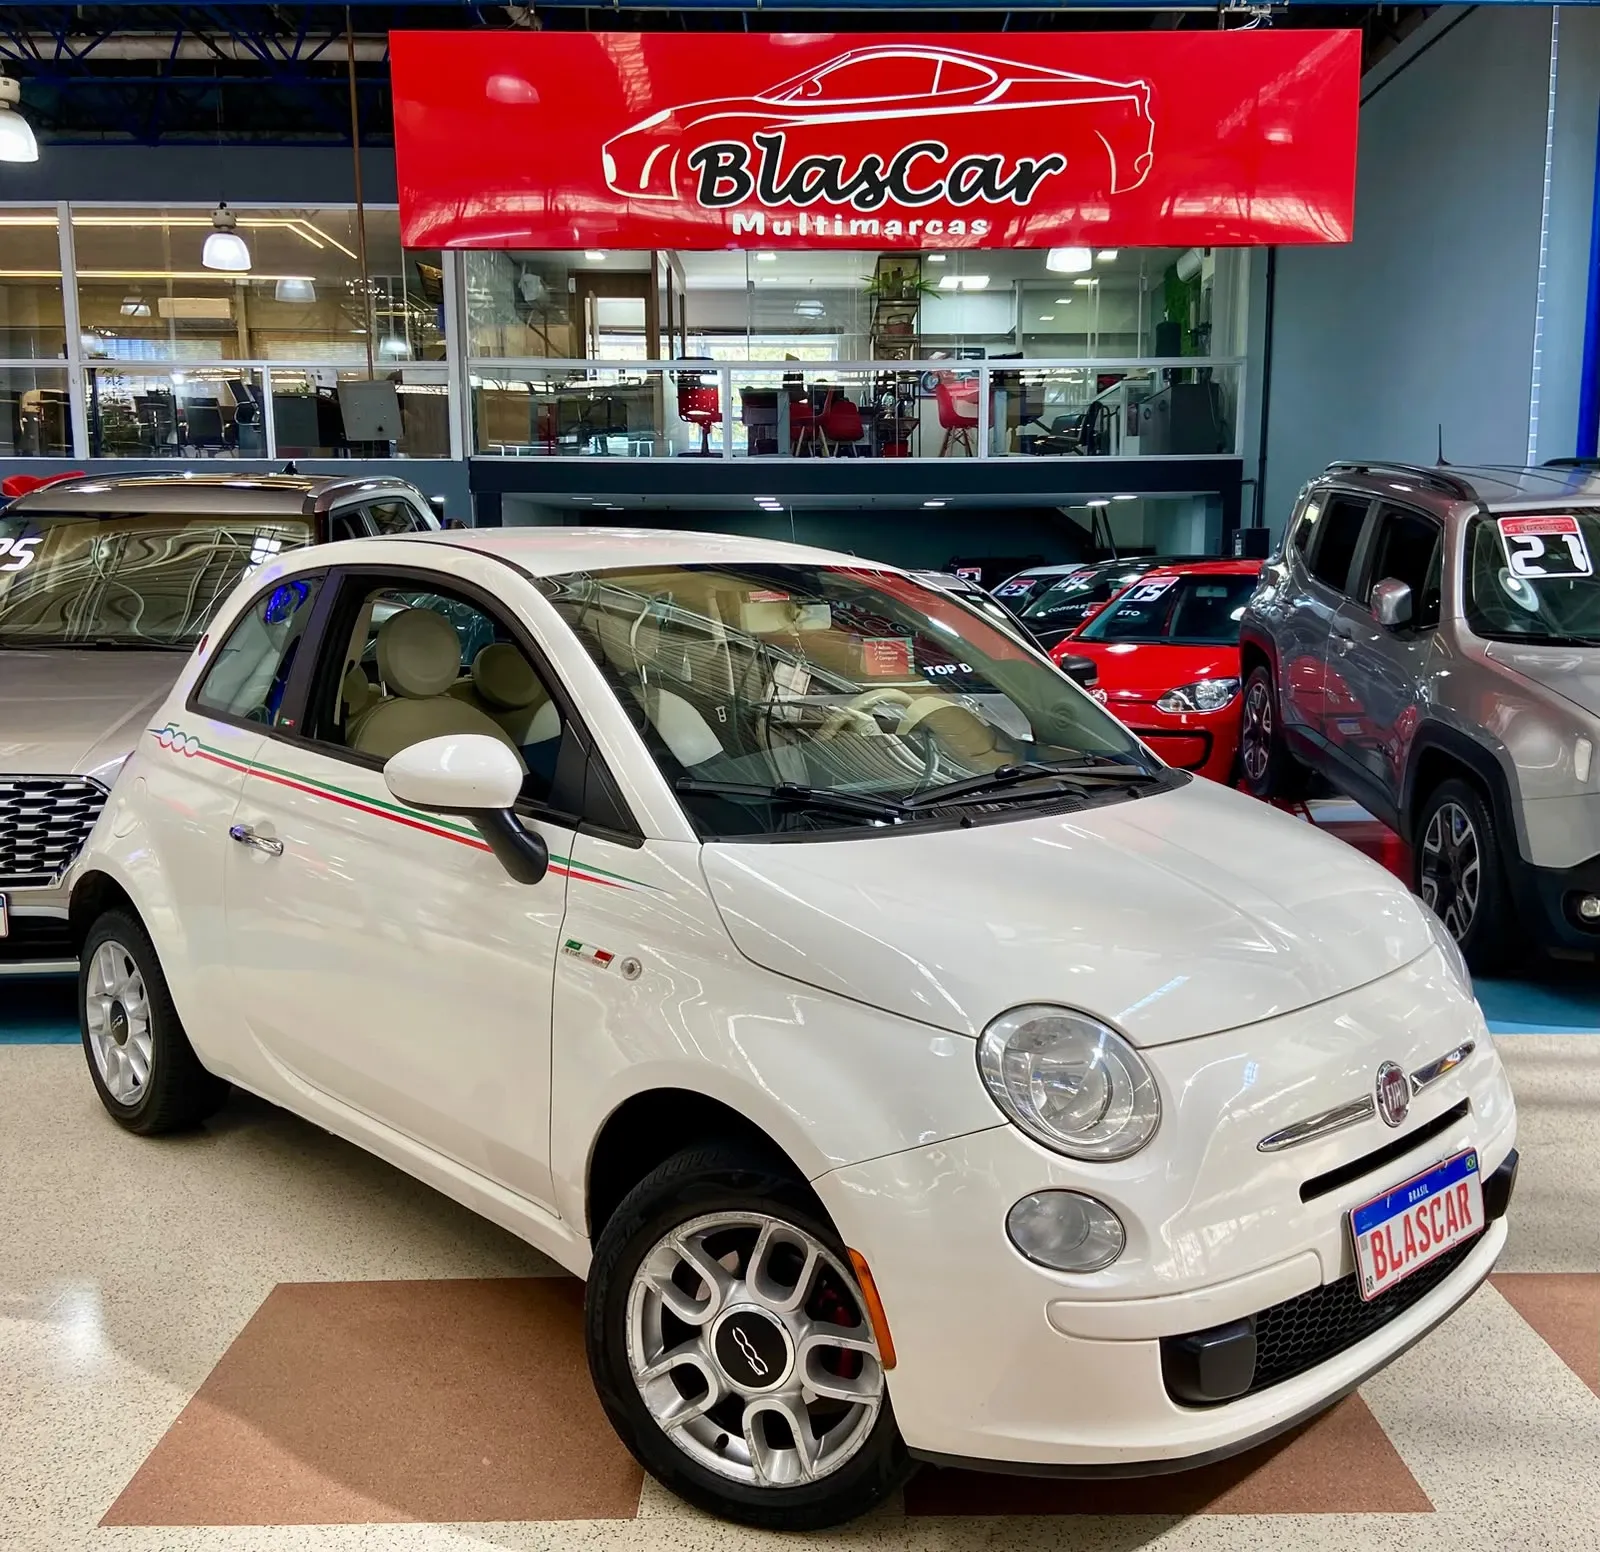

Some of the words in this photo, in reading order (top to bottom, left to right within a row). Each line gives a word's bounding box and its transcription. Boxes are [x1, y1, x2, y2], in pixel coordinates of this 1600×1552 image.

[688, 131, 1068, 209] BlasCar
[732, 212, 990, 237] Multimarcas
[923, 664, 957, 676] TOP
[1408, 1183, 1429, 1203] BRASIL
[1370, 1182, 1472, 1281] BLASCAR
